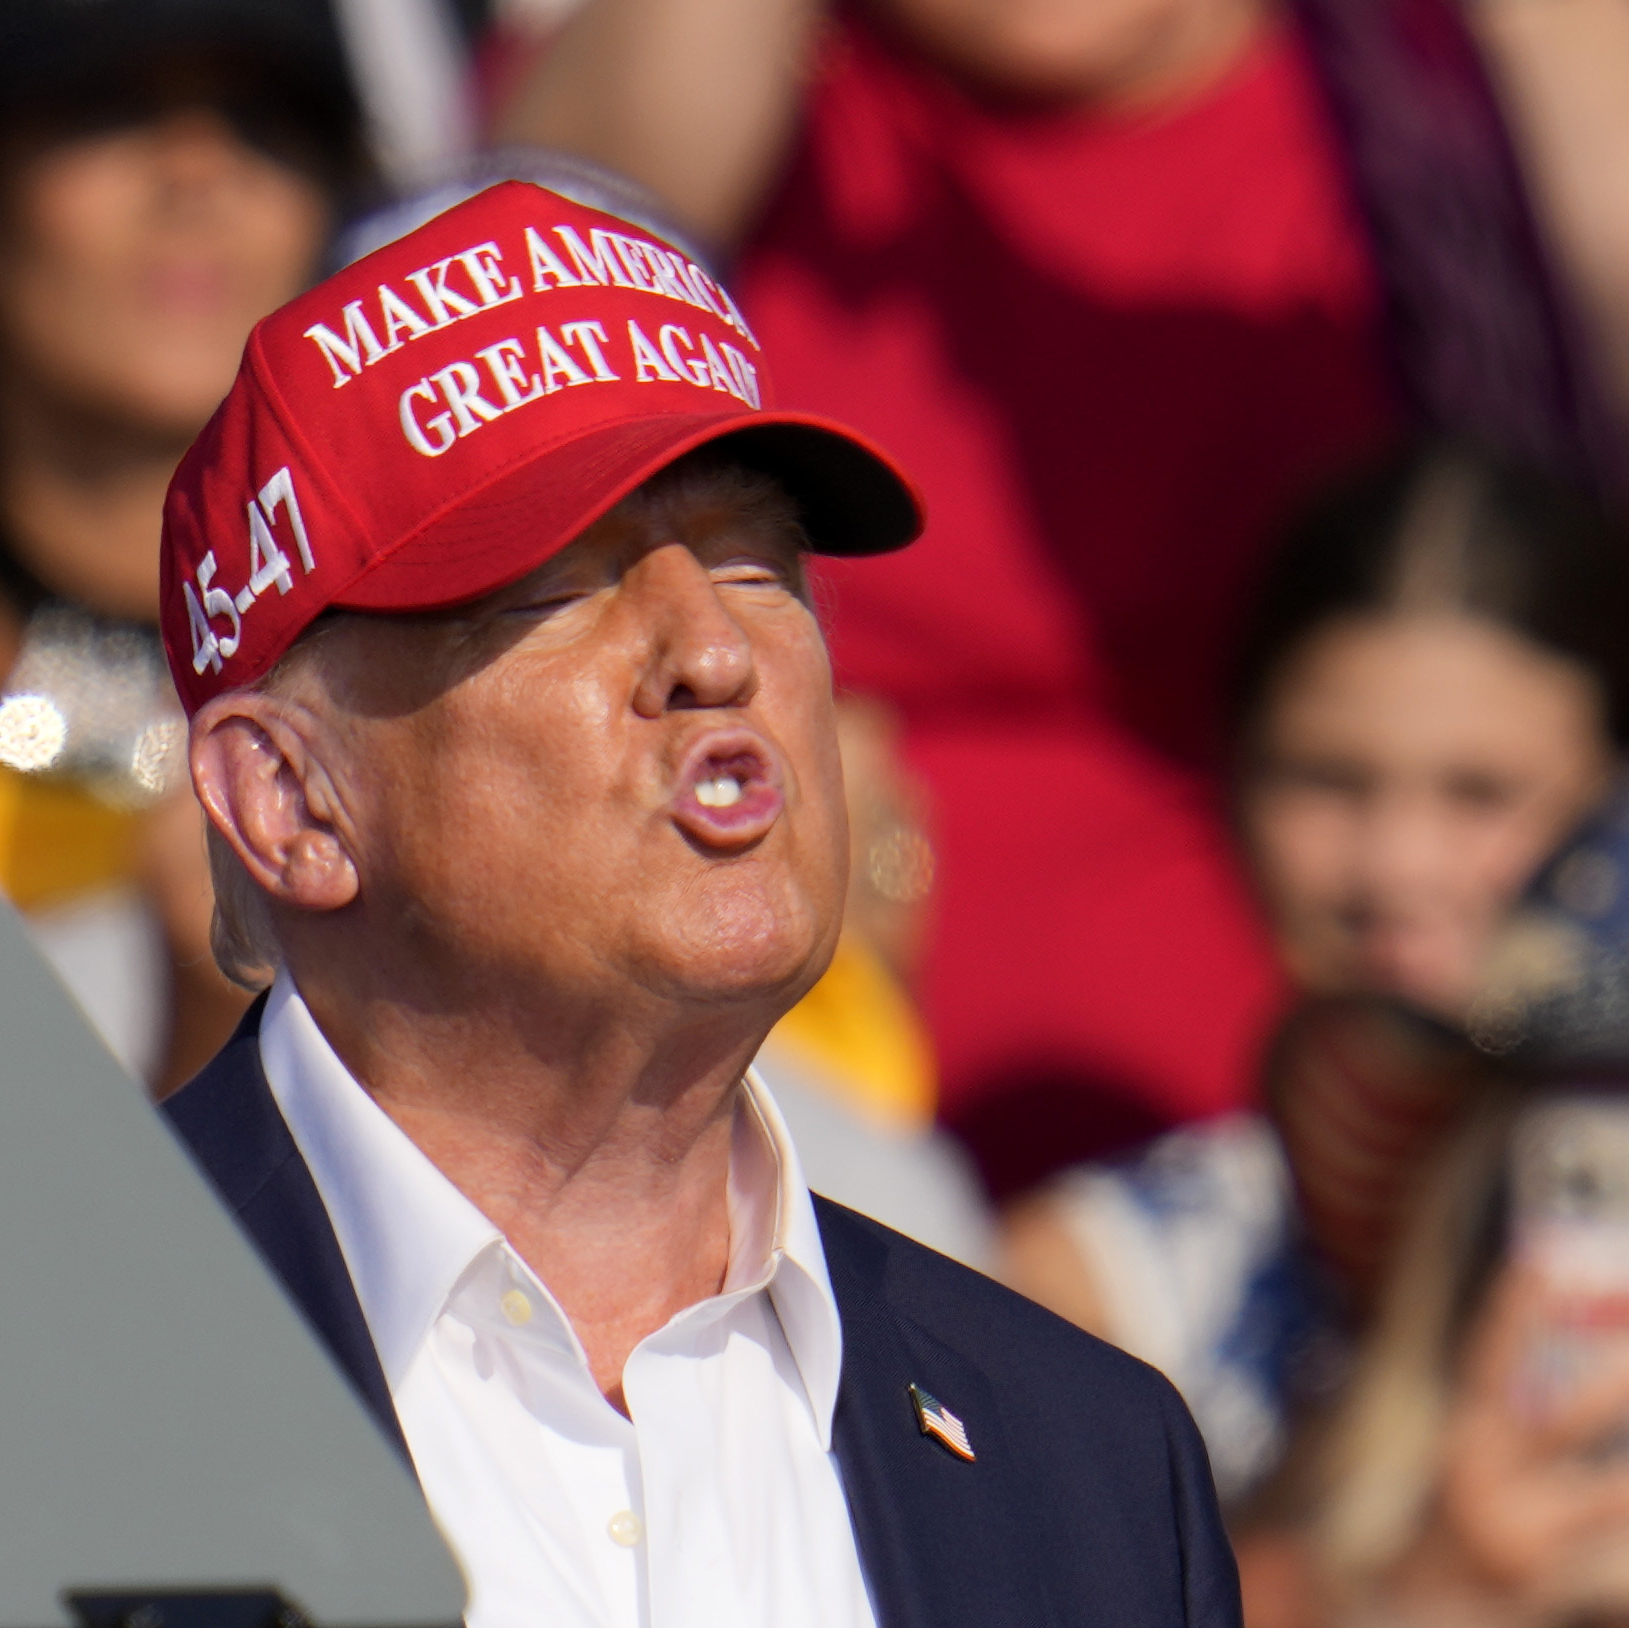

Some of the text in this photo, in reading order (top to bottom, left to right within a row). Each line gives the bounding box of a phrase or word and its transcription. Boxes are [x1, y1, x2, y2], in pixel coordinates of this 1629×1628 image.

[303, 241, 523, 389] MAKE
[399, 320, 621, 458] GREAT
[183, 466, 316, 676] 45-47
